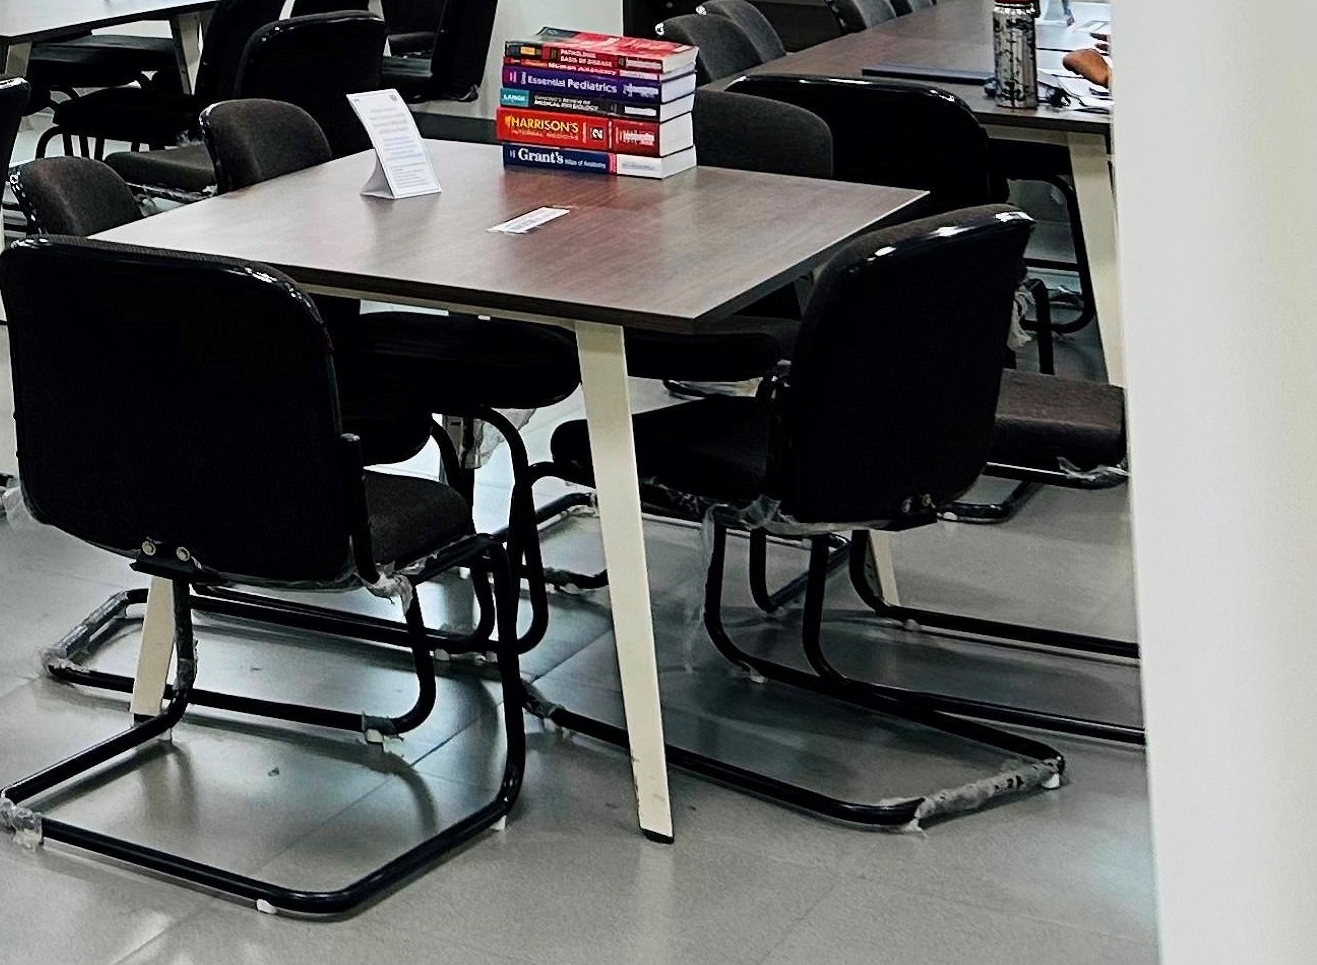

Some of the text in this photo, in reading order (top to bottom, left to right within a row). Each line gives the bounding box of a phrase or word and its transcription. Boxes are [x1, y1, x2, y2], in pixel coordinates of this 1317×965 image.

[527, 75, 566, 88] Essential
[567, 78, 618, 94] Pediatrics
[511, 116, 579, 133] HARRISON'S
[518, 147, 564, 165] Grant's
